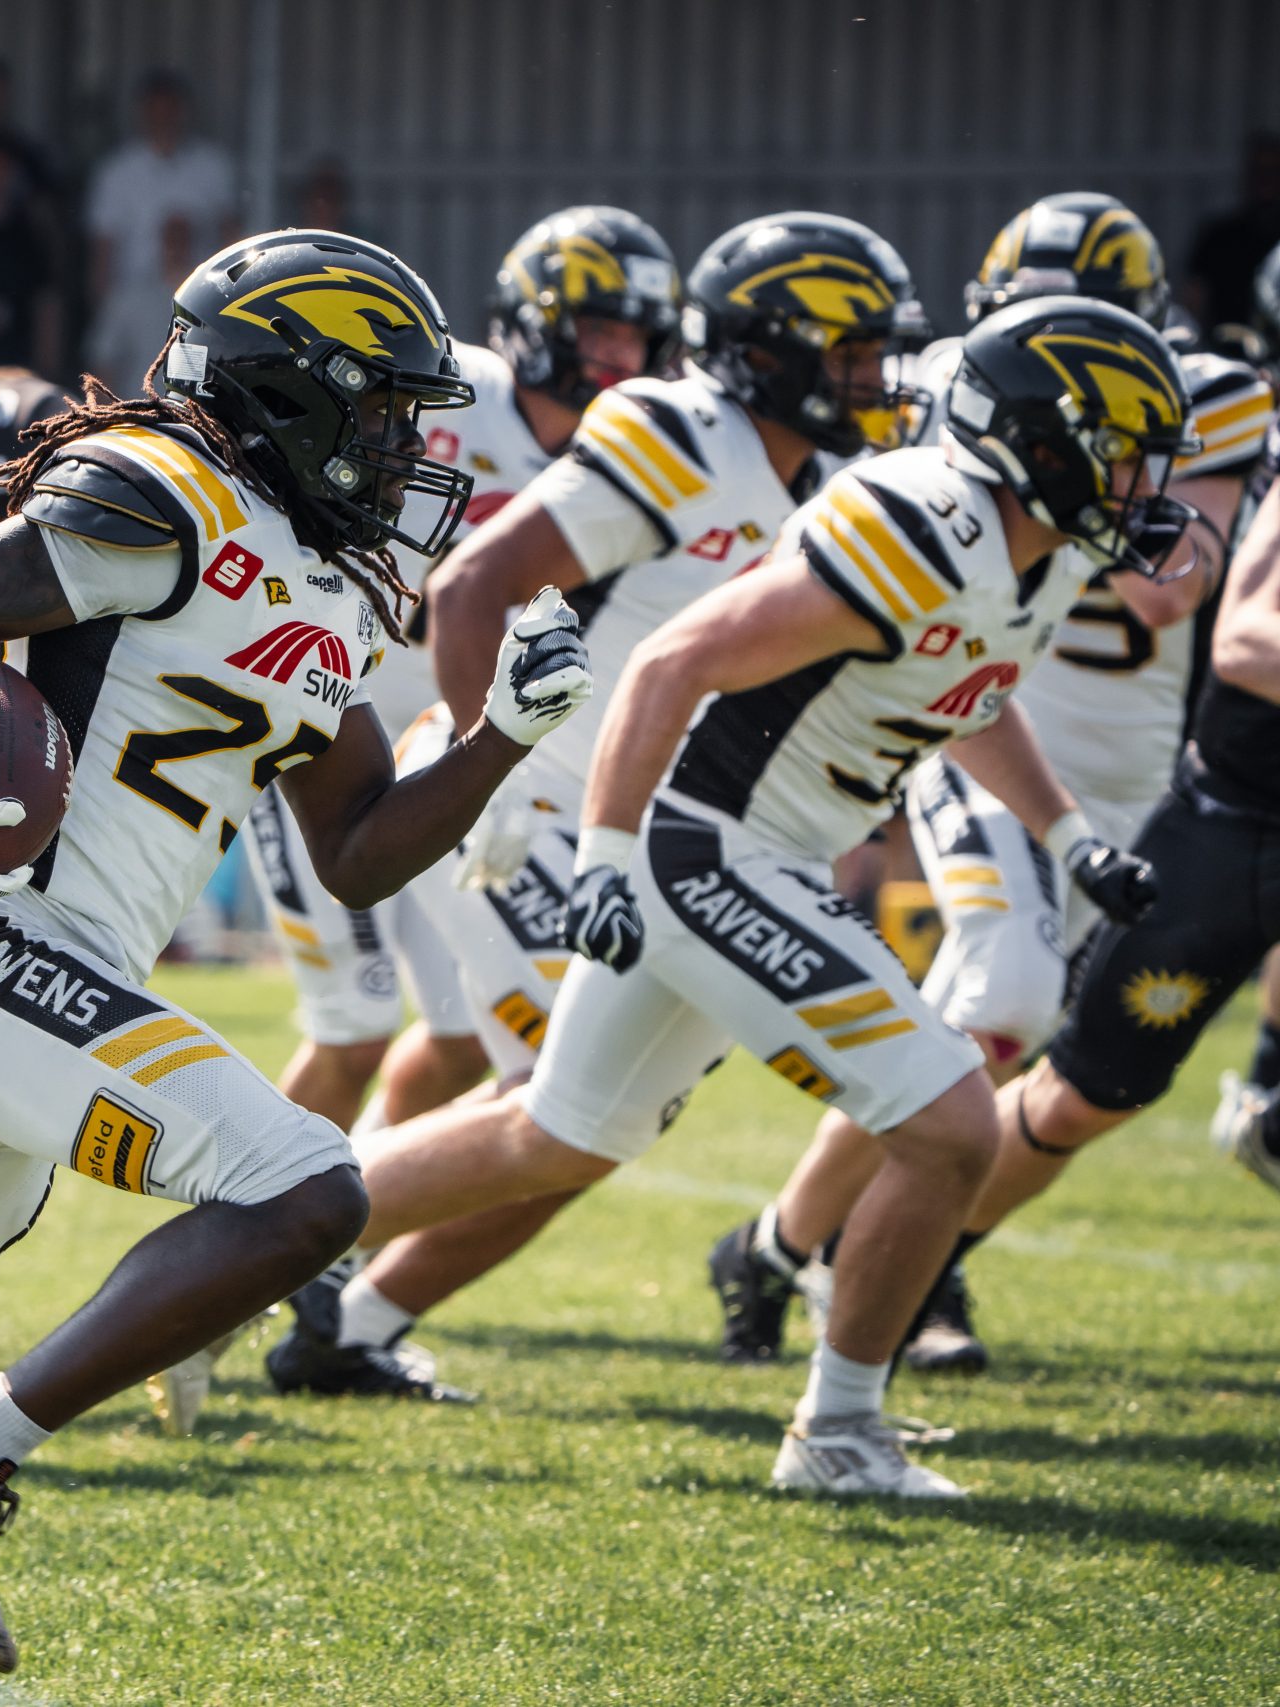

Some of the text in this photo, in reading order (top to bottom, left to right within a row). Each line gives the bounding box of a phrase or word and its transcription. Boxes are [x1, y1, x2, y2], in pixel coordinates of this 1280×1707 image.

[925, 489, 983, 549] 33
[307, 574, 344, 590] capelli
[324, 587, 343, 595] SPORT
[42, 702, 61, 771] Wilson
[491, 866, 568, 941] ENS
[671, 869, 826, 989] RAVENS
